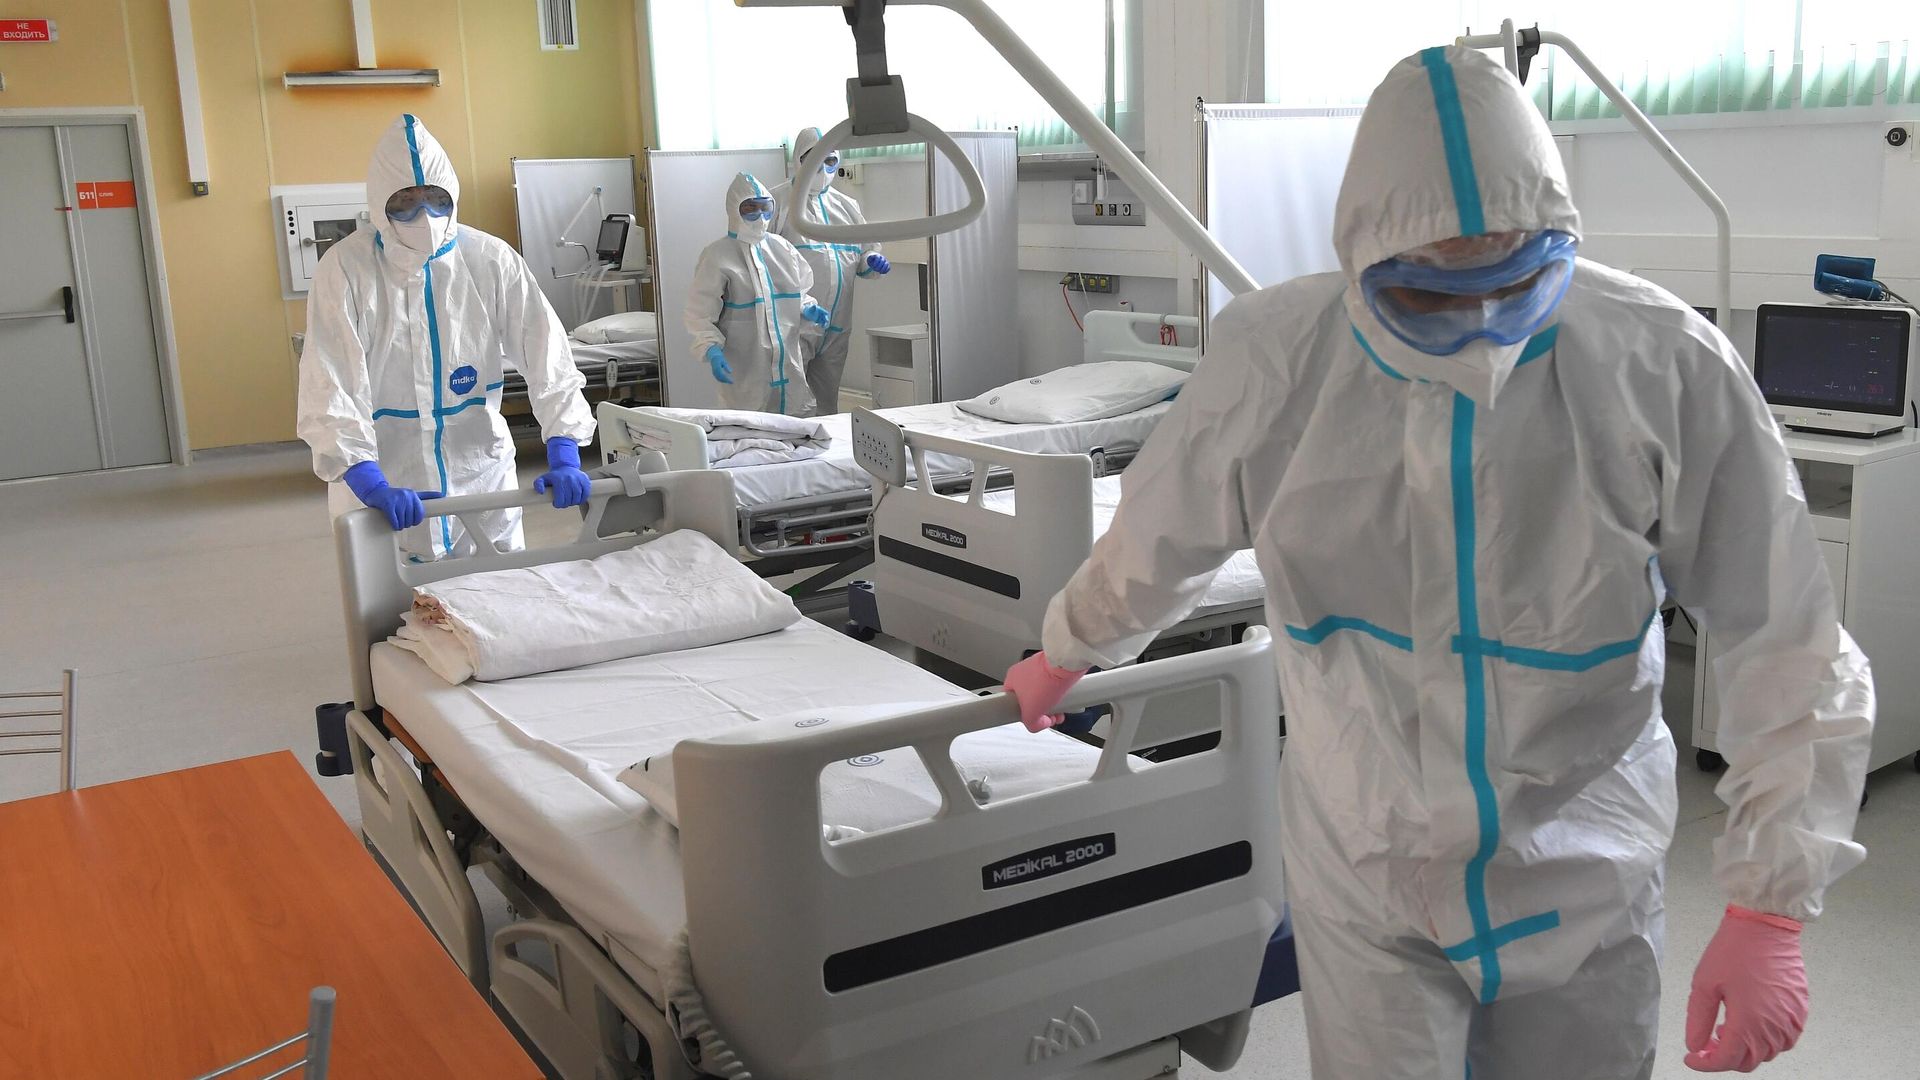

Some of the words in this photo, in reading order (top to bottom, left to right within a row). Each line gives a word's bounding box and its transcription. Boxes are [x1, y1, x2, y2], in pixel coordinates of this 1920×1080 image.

[16, 22, 30, 30] НЕ
[3, 31, 46, 39] ВХОДИТЬ
[949, 534, 964, 545] 2000
[1065, 842, 1104, 863] 2000
